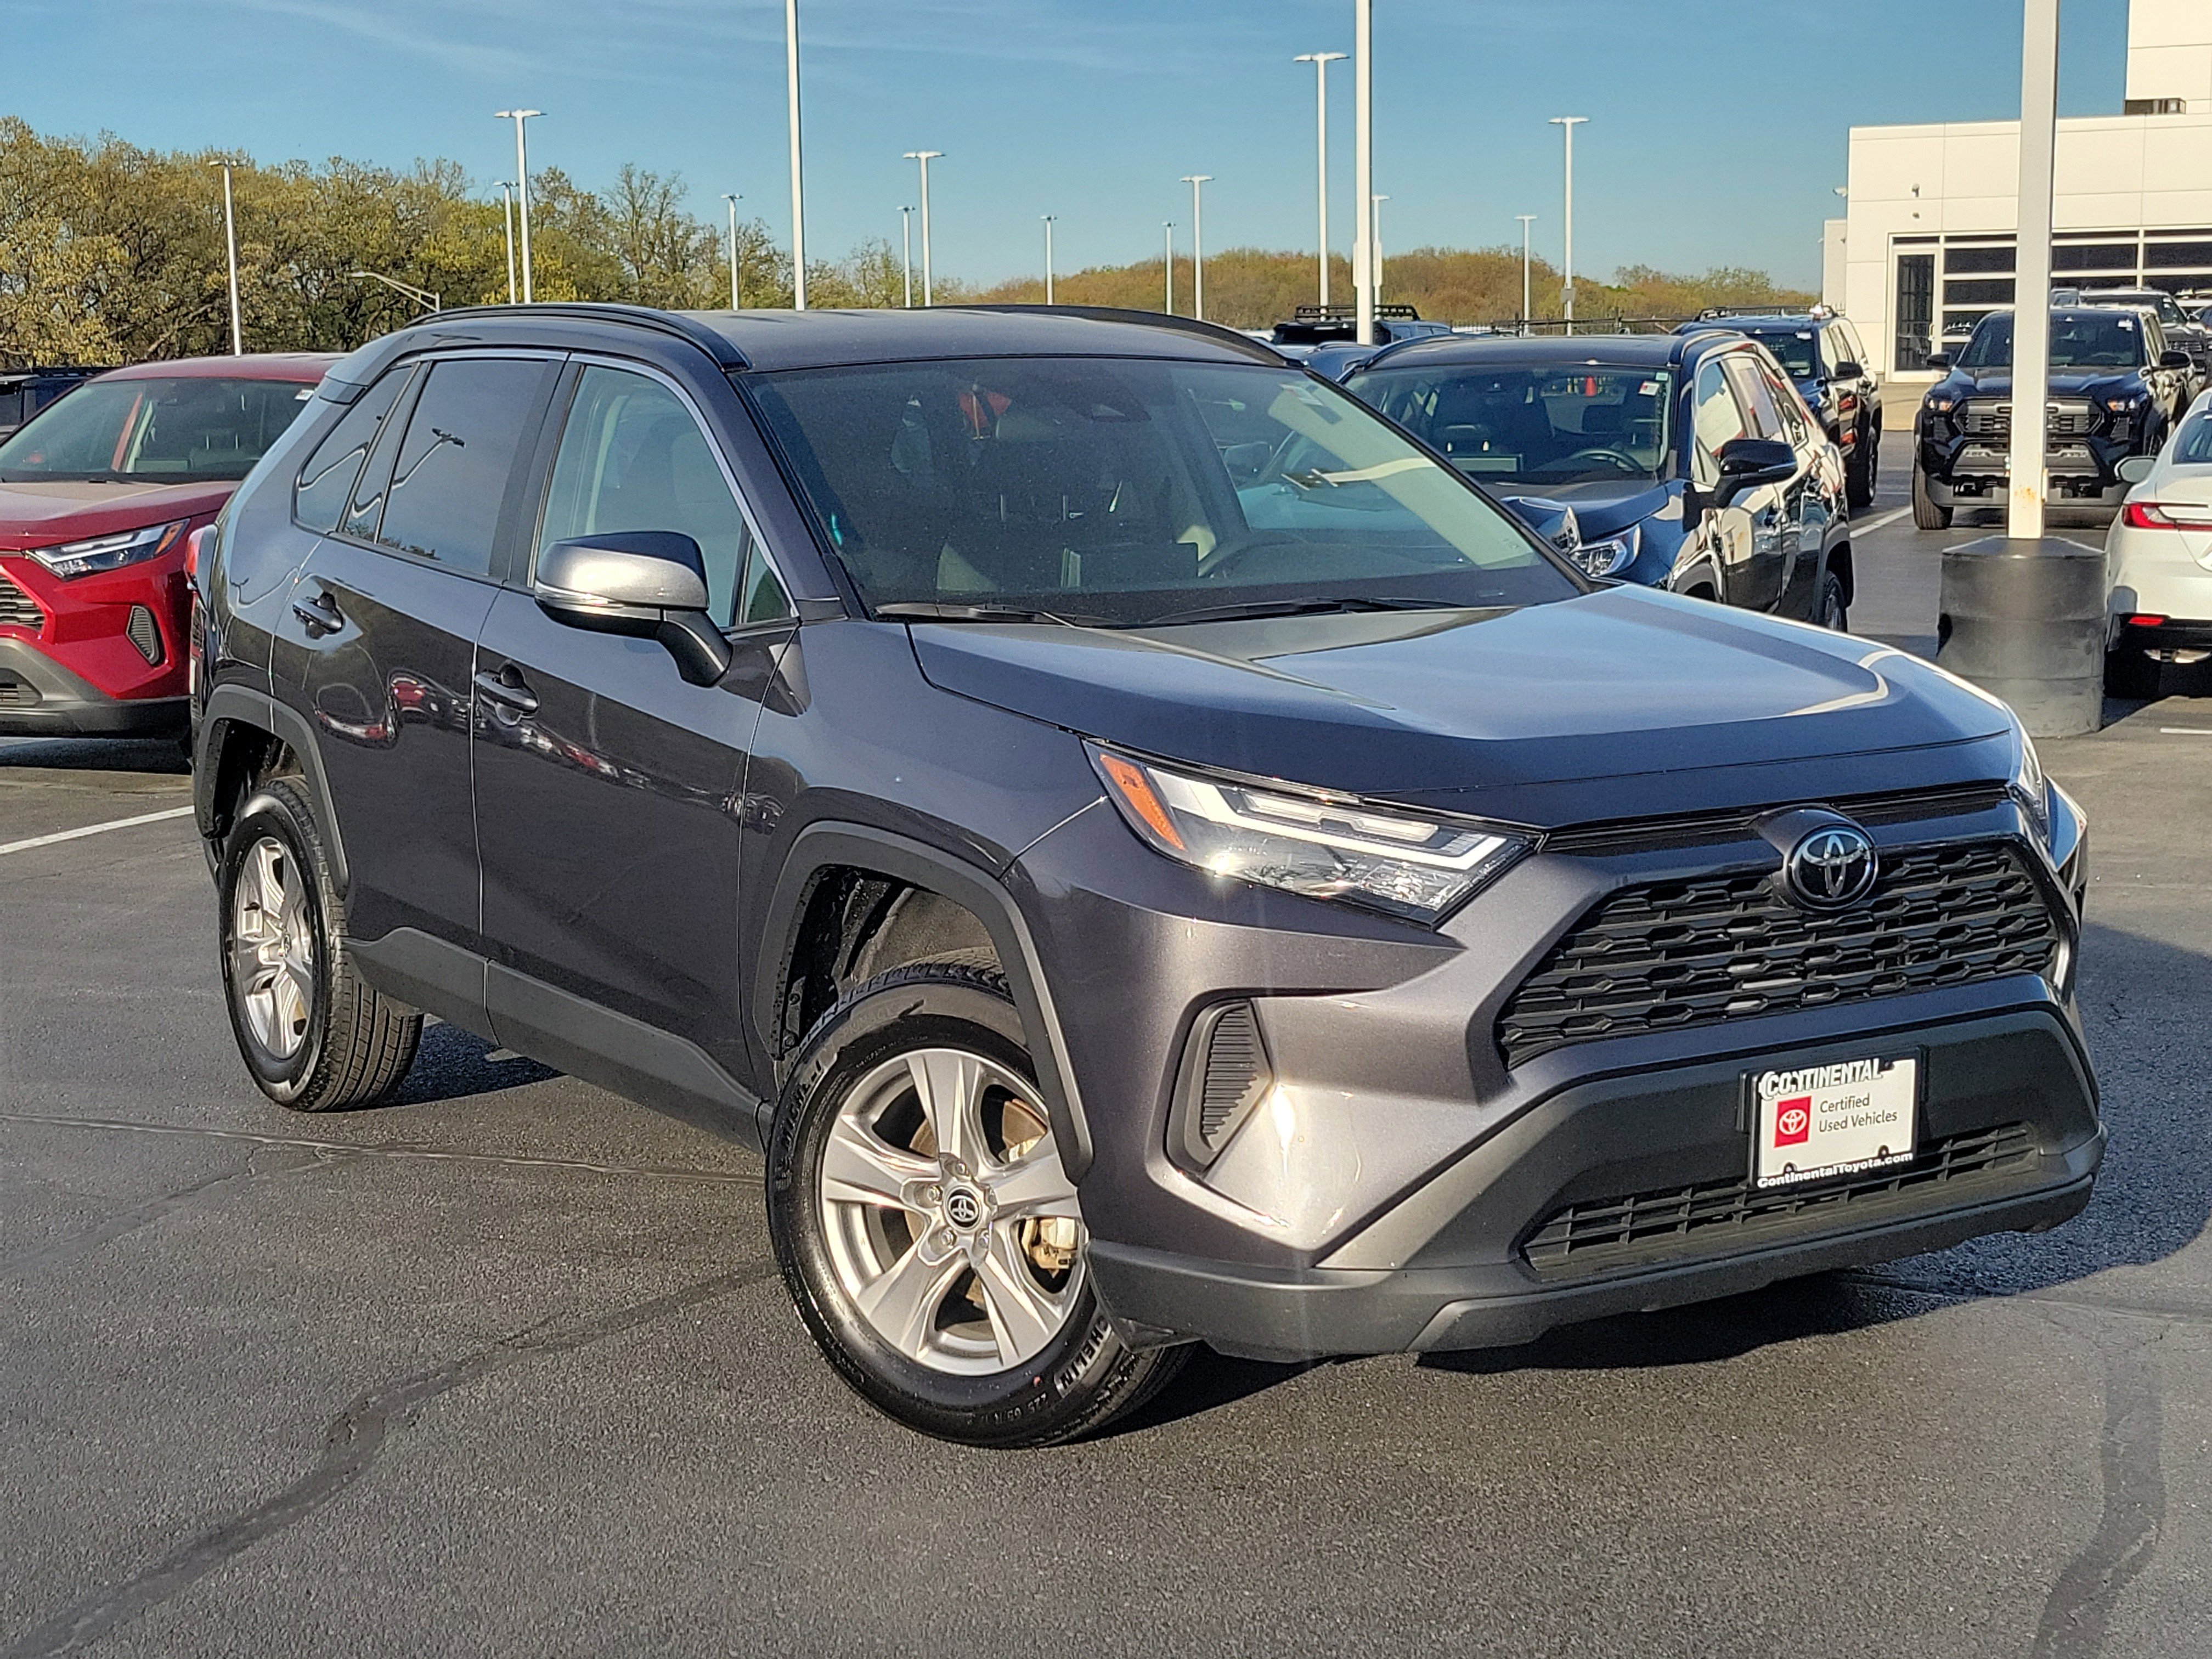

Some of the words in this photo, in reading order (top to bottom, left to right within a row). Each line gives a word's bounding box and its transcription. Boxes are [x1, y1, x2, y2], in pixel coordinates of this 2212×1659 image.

[1758, 1058, 1883, 1101] CONTINENTAL
[1820, 1092, 1870, 1113] Certified
[1819, 1116, 1848, 1132] Used
[1851, 1110, 1898, 1128] Vehicles
[1757, 1153, 1914, 1188] ContinentalToyota.com
[1059, 1315, 1110, 1391] CHELIN
